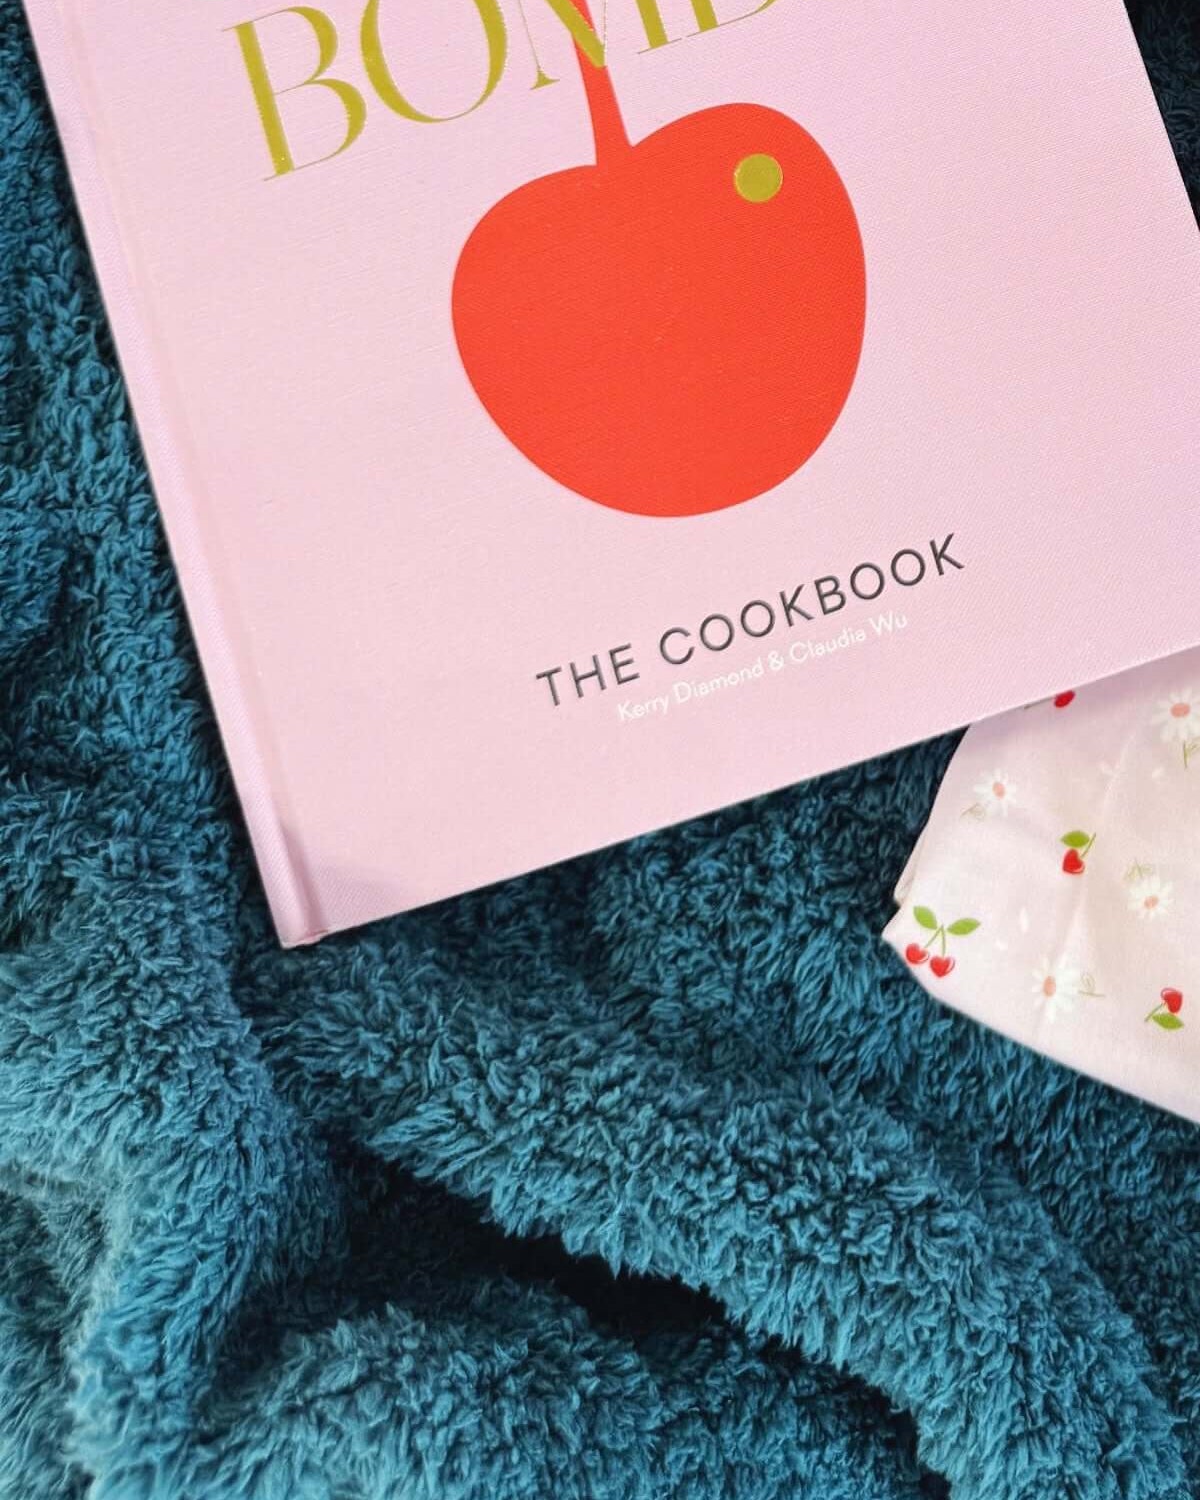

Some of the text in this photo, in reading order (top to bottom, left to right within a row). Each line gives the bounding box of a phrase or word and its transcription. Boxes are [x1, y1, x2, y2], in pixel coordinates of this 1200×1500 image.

[536, 532, 966, 707] THE COOKBOOK
[616, 610, 908, 723] Kerry Diamond & Claudia Wu
